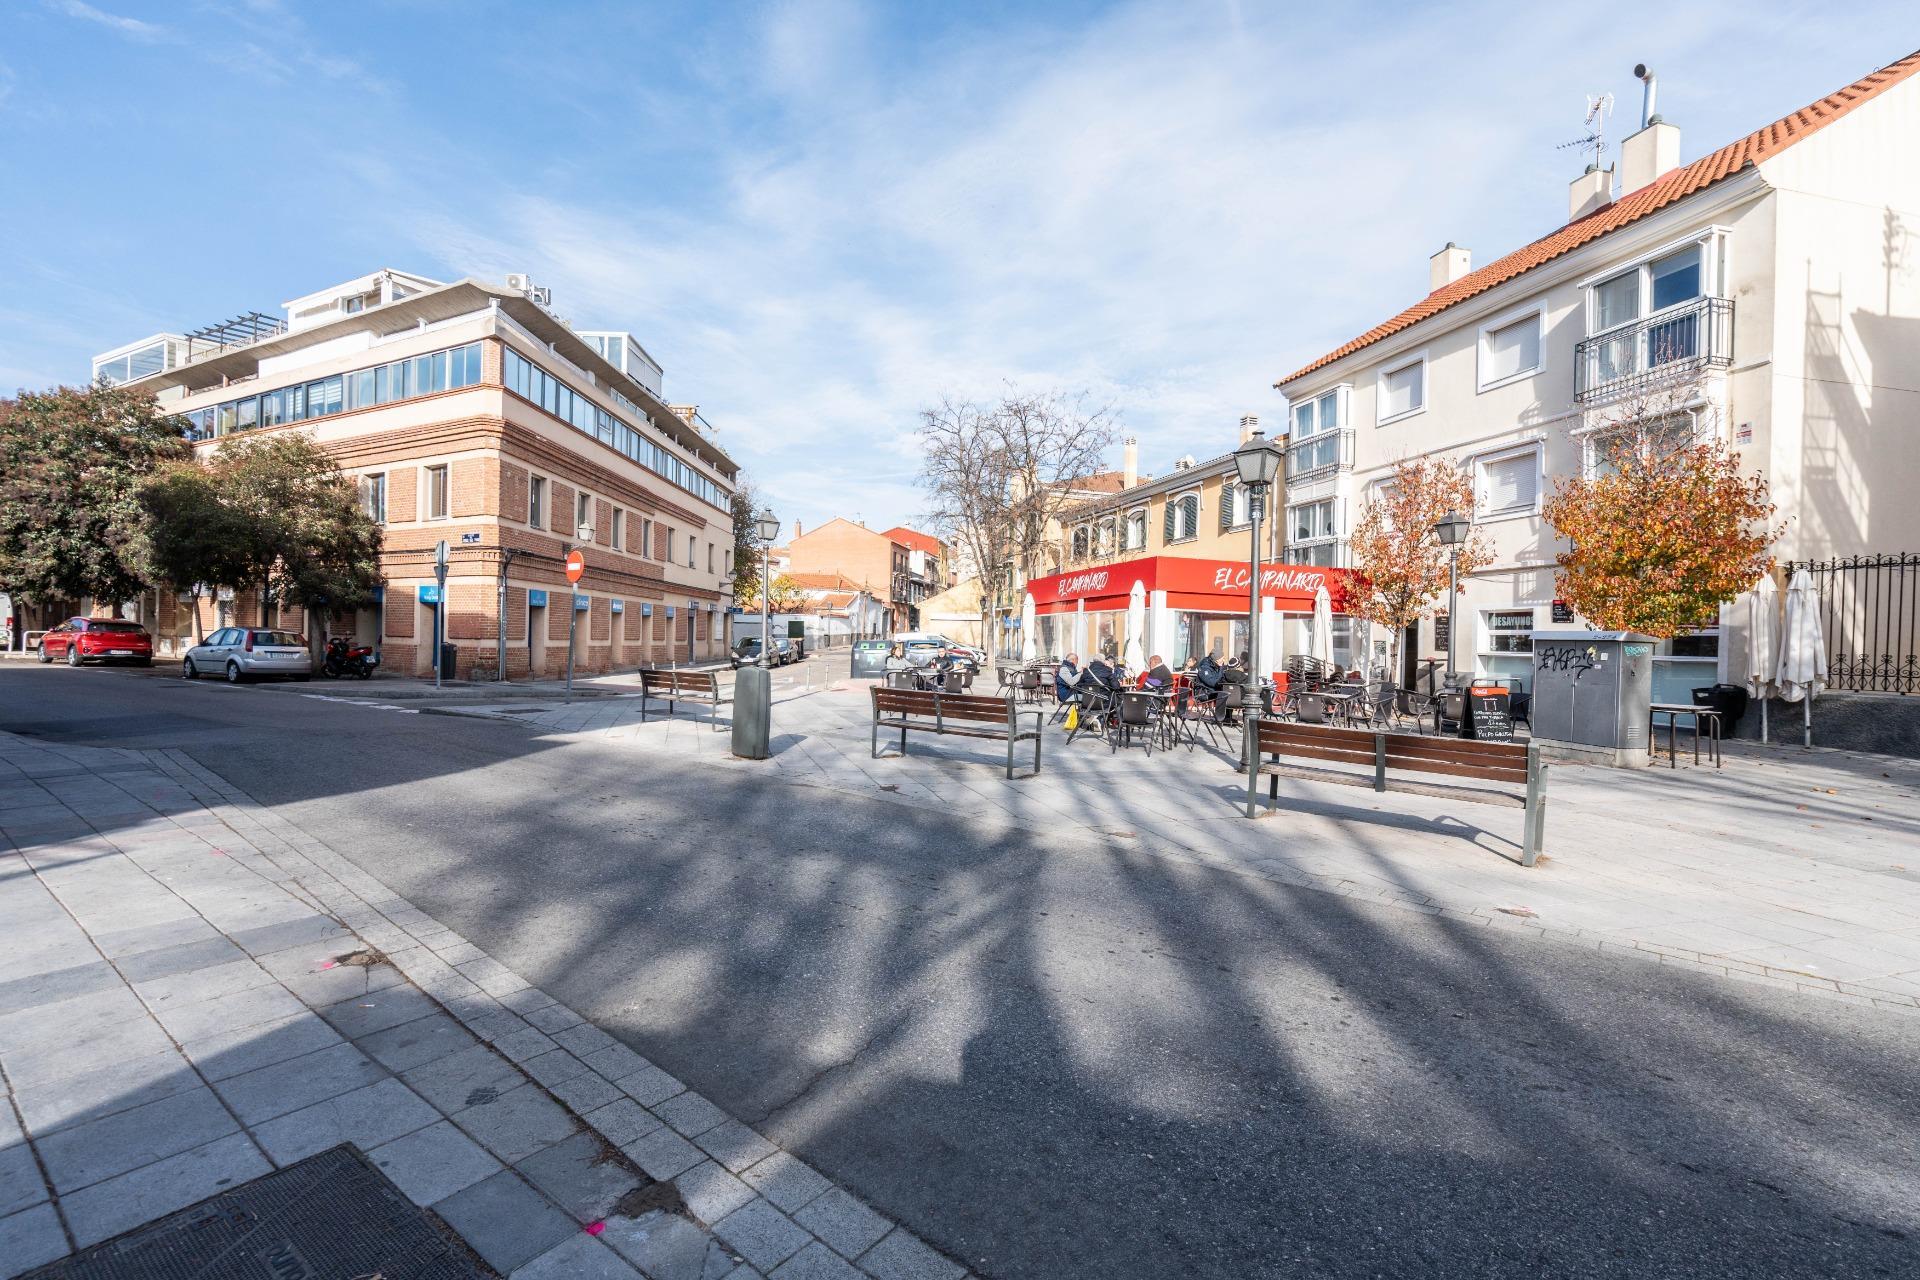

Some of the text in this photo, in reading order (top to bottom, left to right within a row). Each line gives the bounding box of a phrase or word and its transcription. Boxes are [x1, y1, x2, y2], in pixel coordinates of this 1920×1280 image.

[1058, 571, 1109, 597] EL CAMPANARIO
[1214, 567, 1238, 591] EL
